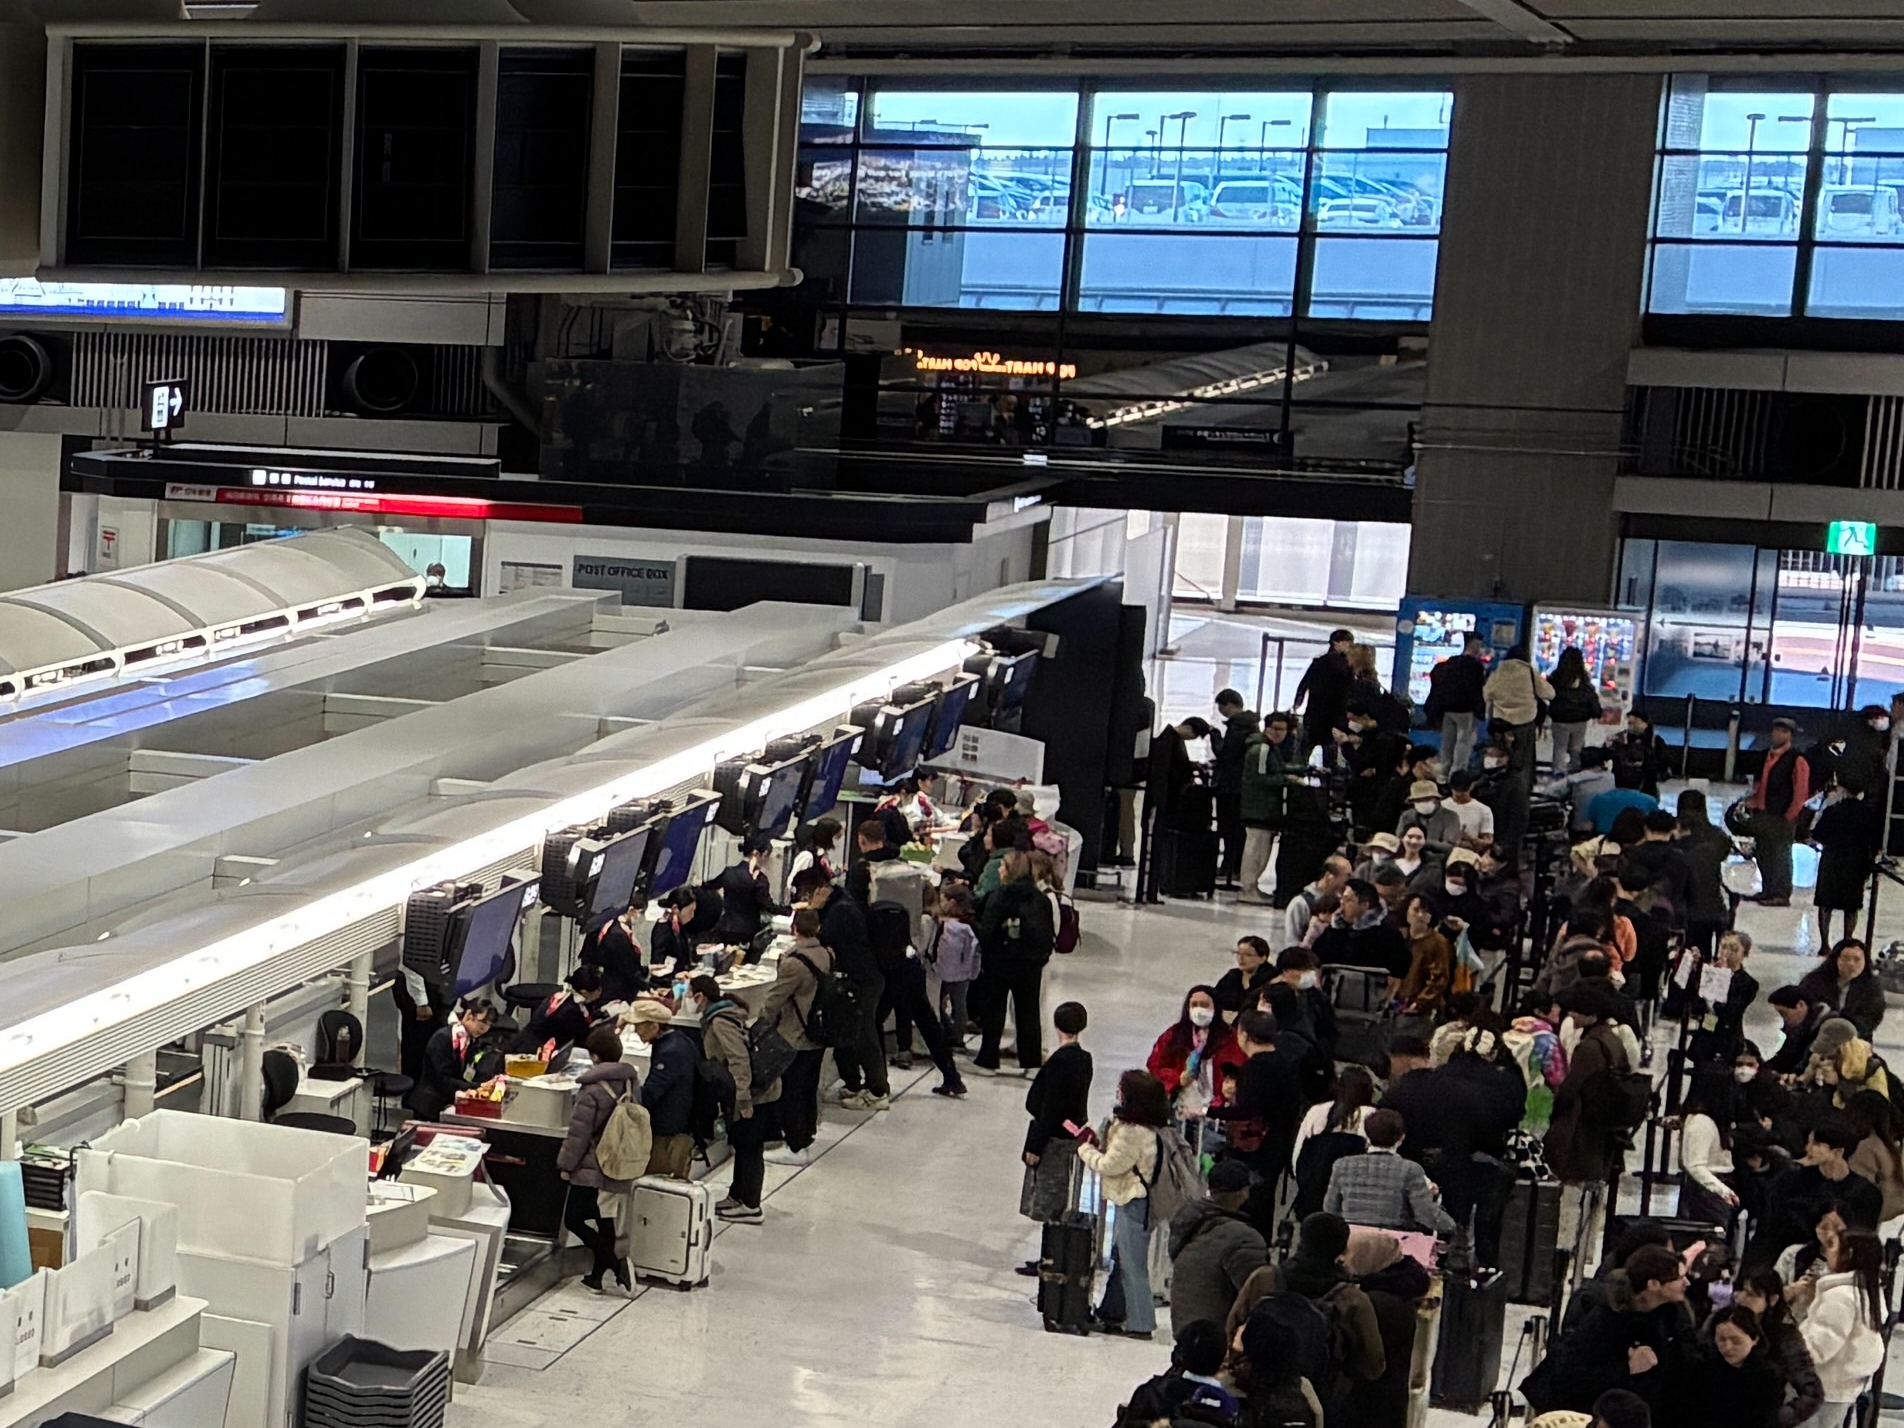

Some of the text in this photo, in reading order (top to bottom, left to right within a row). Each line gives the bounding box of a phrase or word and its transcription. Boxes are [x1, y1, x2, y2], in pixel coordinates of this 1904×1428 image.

[579, 563, 669, 580] POST OFFICE BOX
